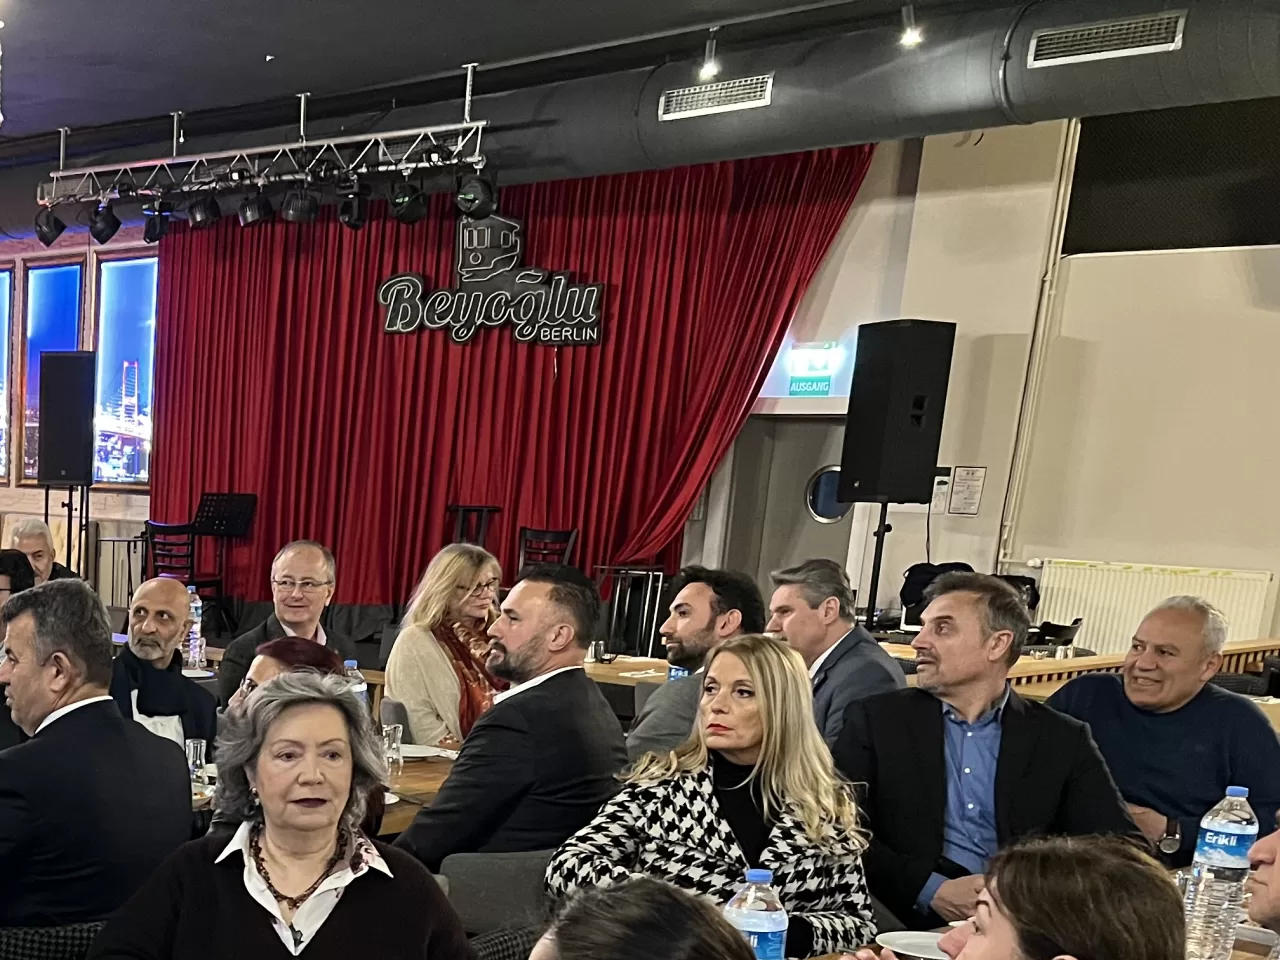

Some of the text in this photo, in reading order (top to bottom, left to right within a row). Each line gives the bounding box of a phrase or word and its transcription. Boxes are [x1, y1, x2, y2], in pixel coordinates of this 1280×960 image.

[540, 327, 598, 341] BERLIN
[790, 381, 829, 392] AUSGANG
[1204, 831, 1237, 847] Erikli
